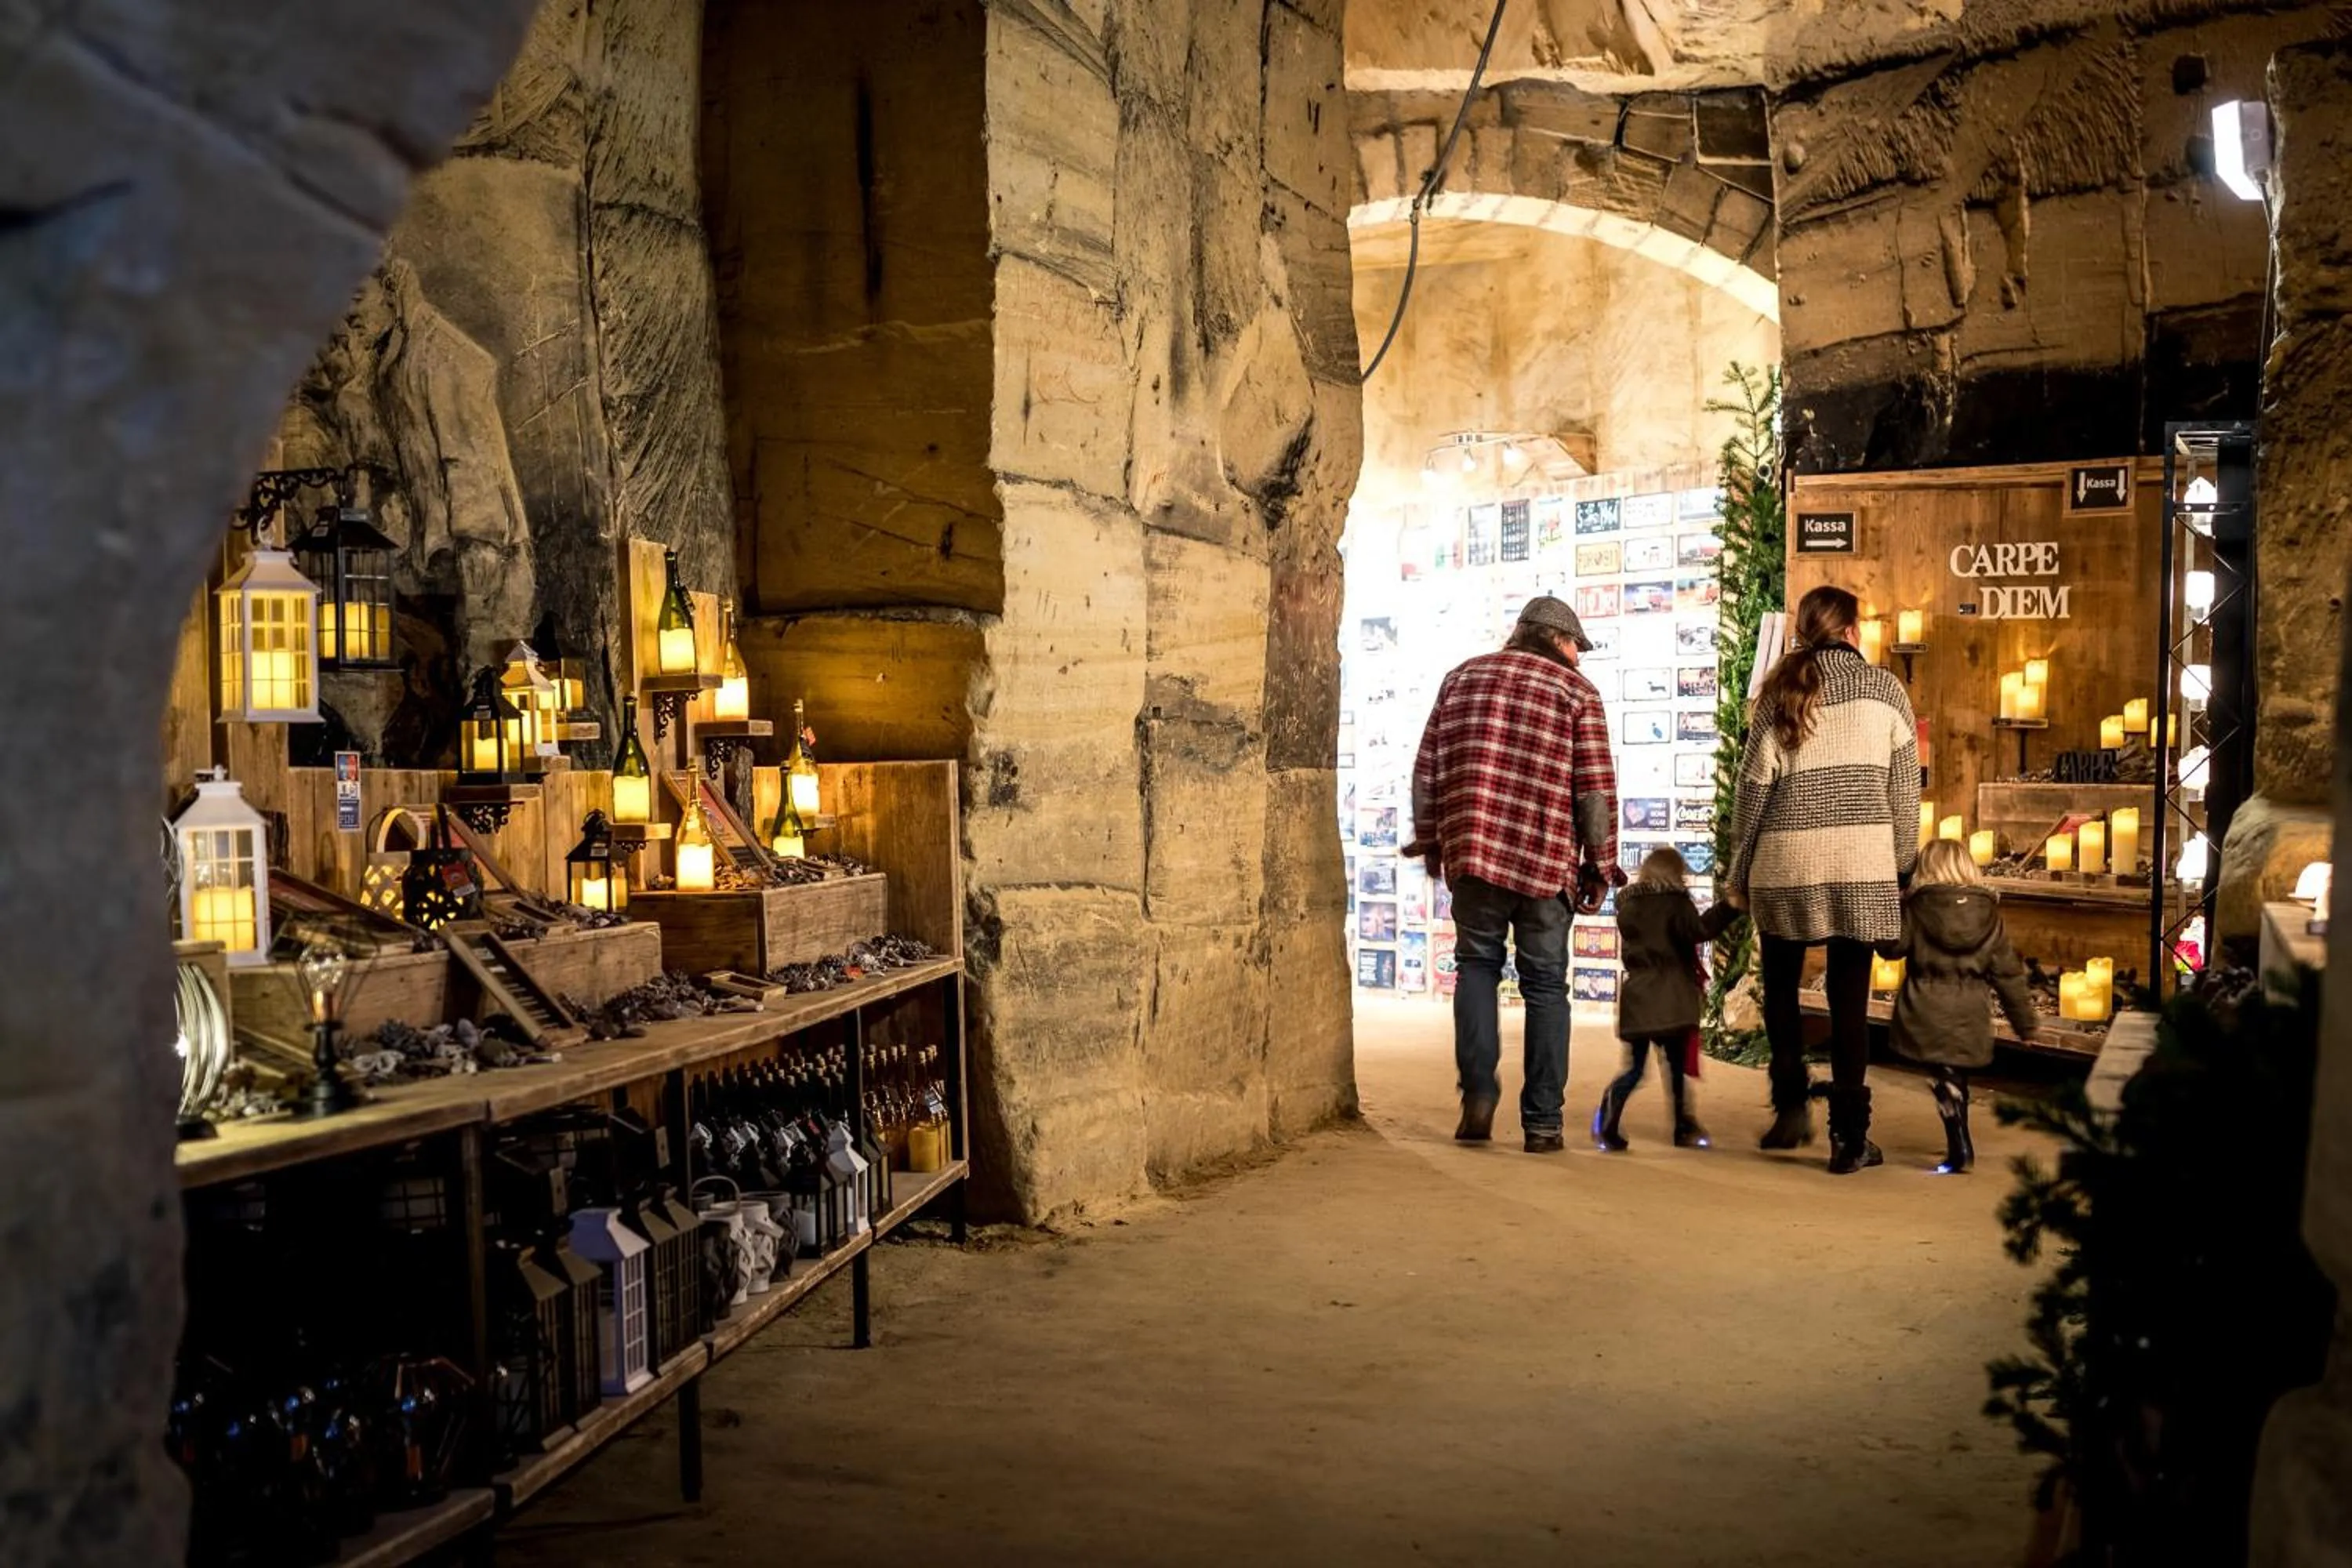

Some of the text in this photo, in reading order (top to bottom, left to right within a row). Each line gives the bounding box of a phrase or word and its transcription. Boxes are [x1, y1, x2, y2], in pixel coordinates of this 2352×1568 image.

[2086, 477, 2116, 489] Kassa
[1804, 518, 1846, 532] Kassa
[1950, 542, 2060, 578] CARPE
[1979, 586, 2072, 619] DIEM
